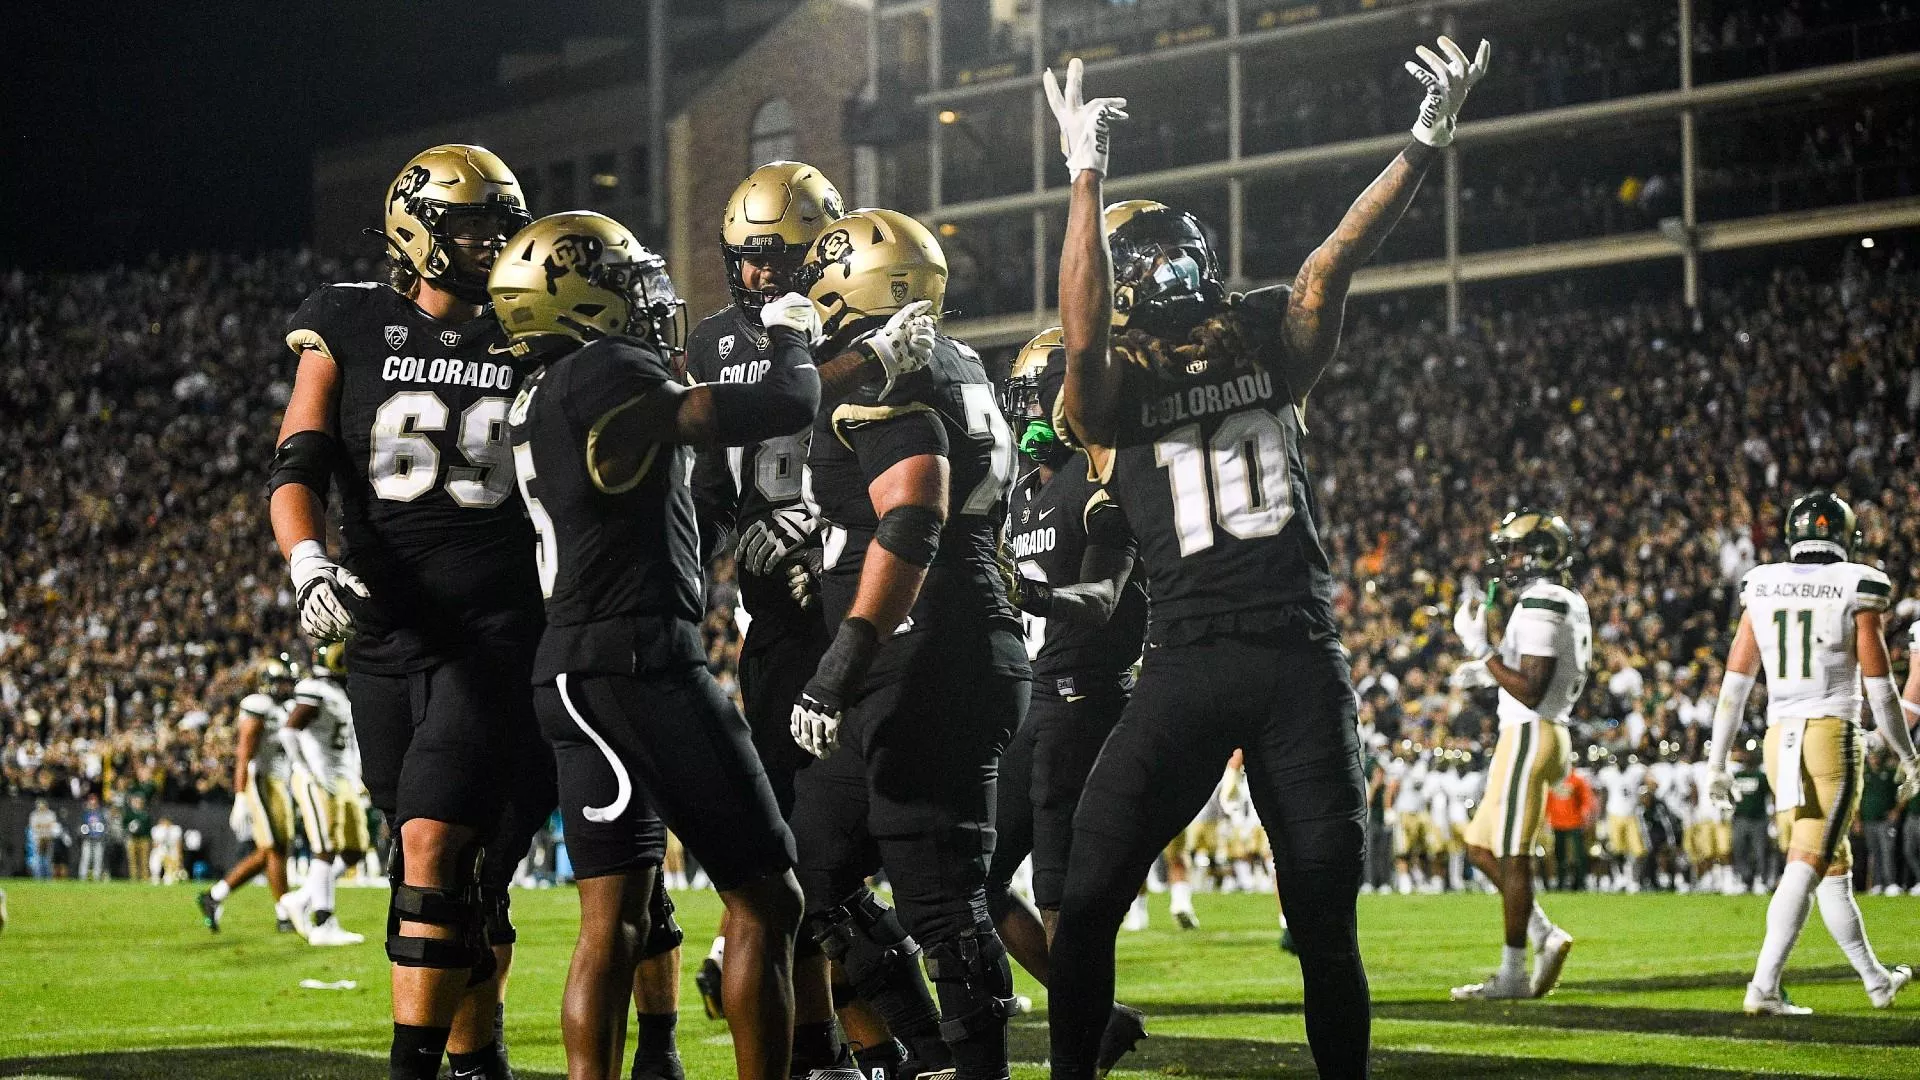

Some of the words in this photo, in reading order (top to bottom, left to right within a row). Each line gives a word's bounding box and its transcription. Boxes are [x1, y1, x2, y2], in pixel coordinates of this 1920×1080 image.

[752, 237, 773, 246] BUFFS
[382, 355, 513, 390] COLORADO
[720, 359, 772, 385] COLOR
[368, 390, 517, 509] 69
[1154, 407, 1295, 558] 10
[1013, 527, 1056, 559] ORADO
[1756, 583, 1843, 599] BLACKBURN
[1773, 608, 1812, 679] 11
